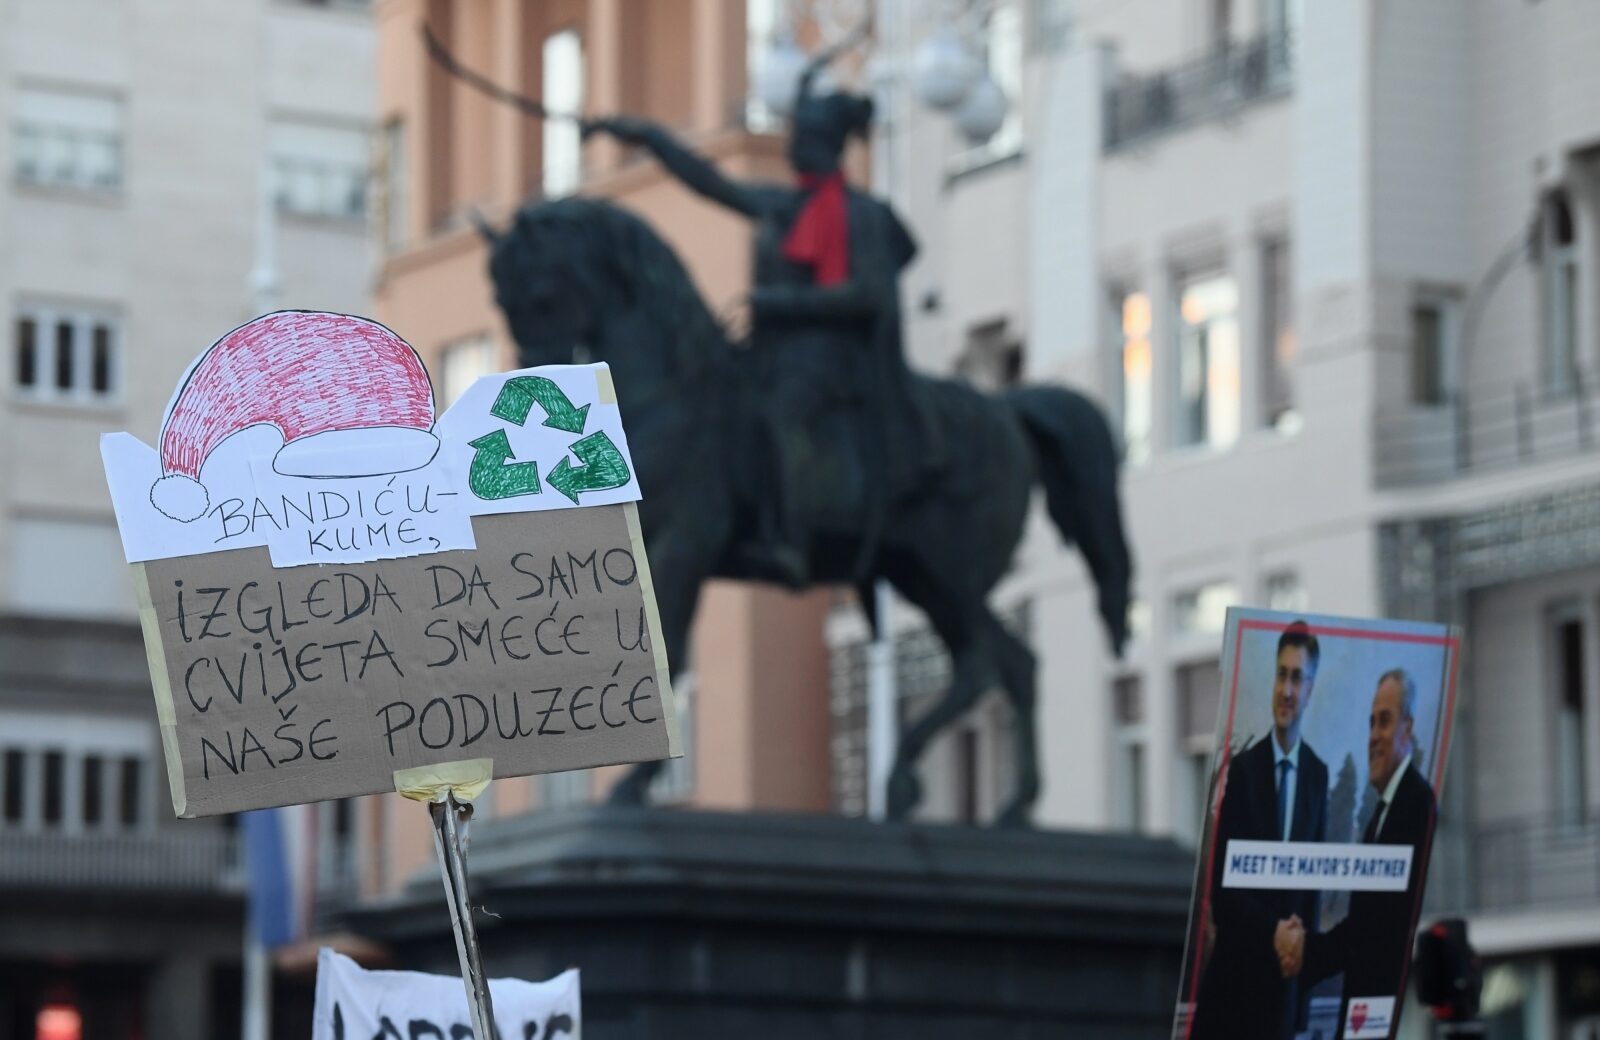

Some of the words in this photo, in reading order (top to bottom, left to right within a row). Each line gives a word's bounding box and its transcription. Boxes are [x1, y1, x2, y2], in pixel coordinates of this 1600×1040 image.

[308, 518, 441, 555] KUME,
[425, 564, 499, 611] DA
[510, 547, 637, 601] SAMO
[424, 600, 591, 667] SMEĆE
[201, 704, 339, 780] NAŠE
[375, 661, 658, 756] PODUZEĆE
[1230, 854, 1267, 874] MEET
[1271, 855, 1294, 876] THE
[1297, 856, 1350, 877] MAYOR'S
[1352, 858, 1406, 878] PARTNER
